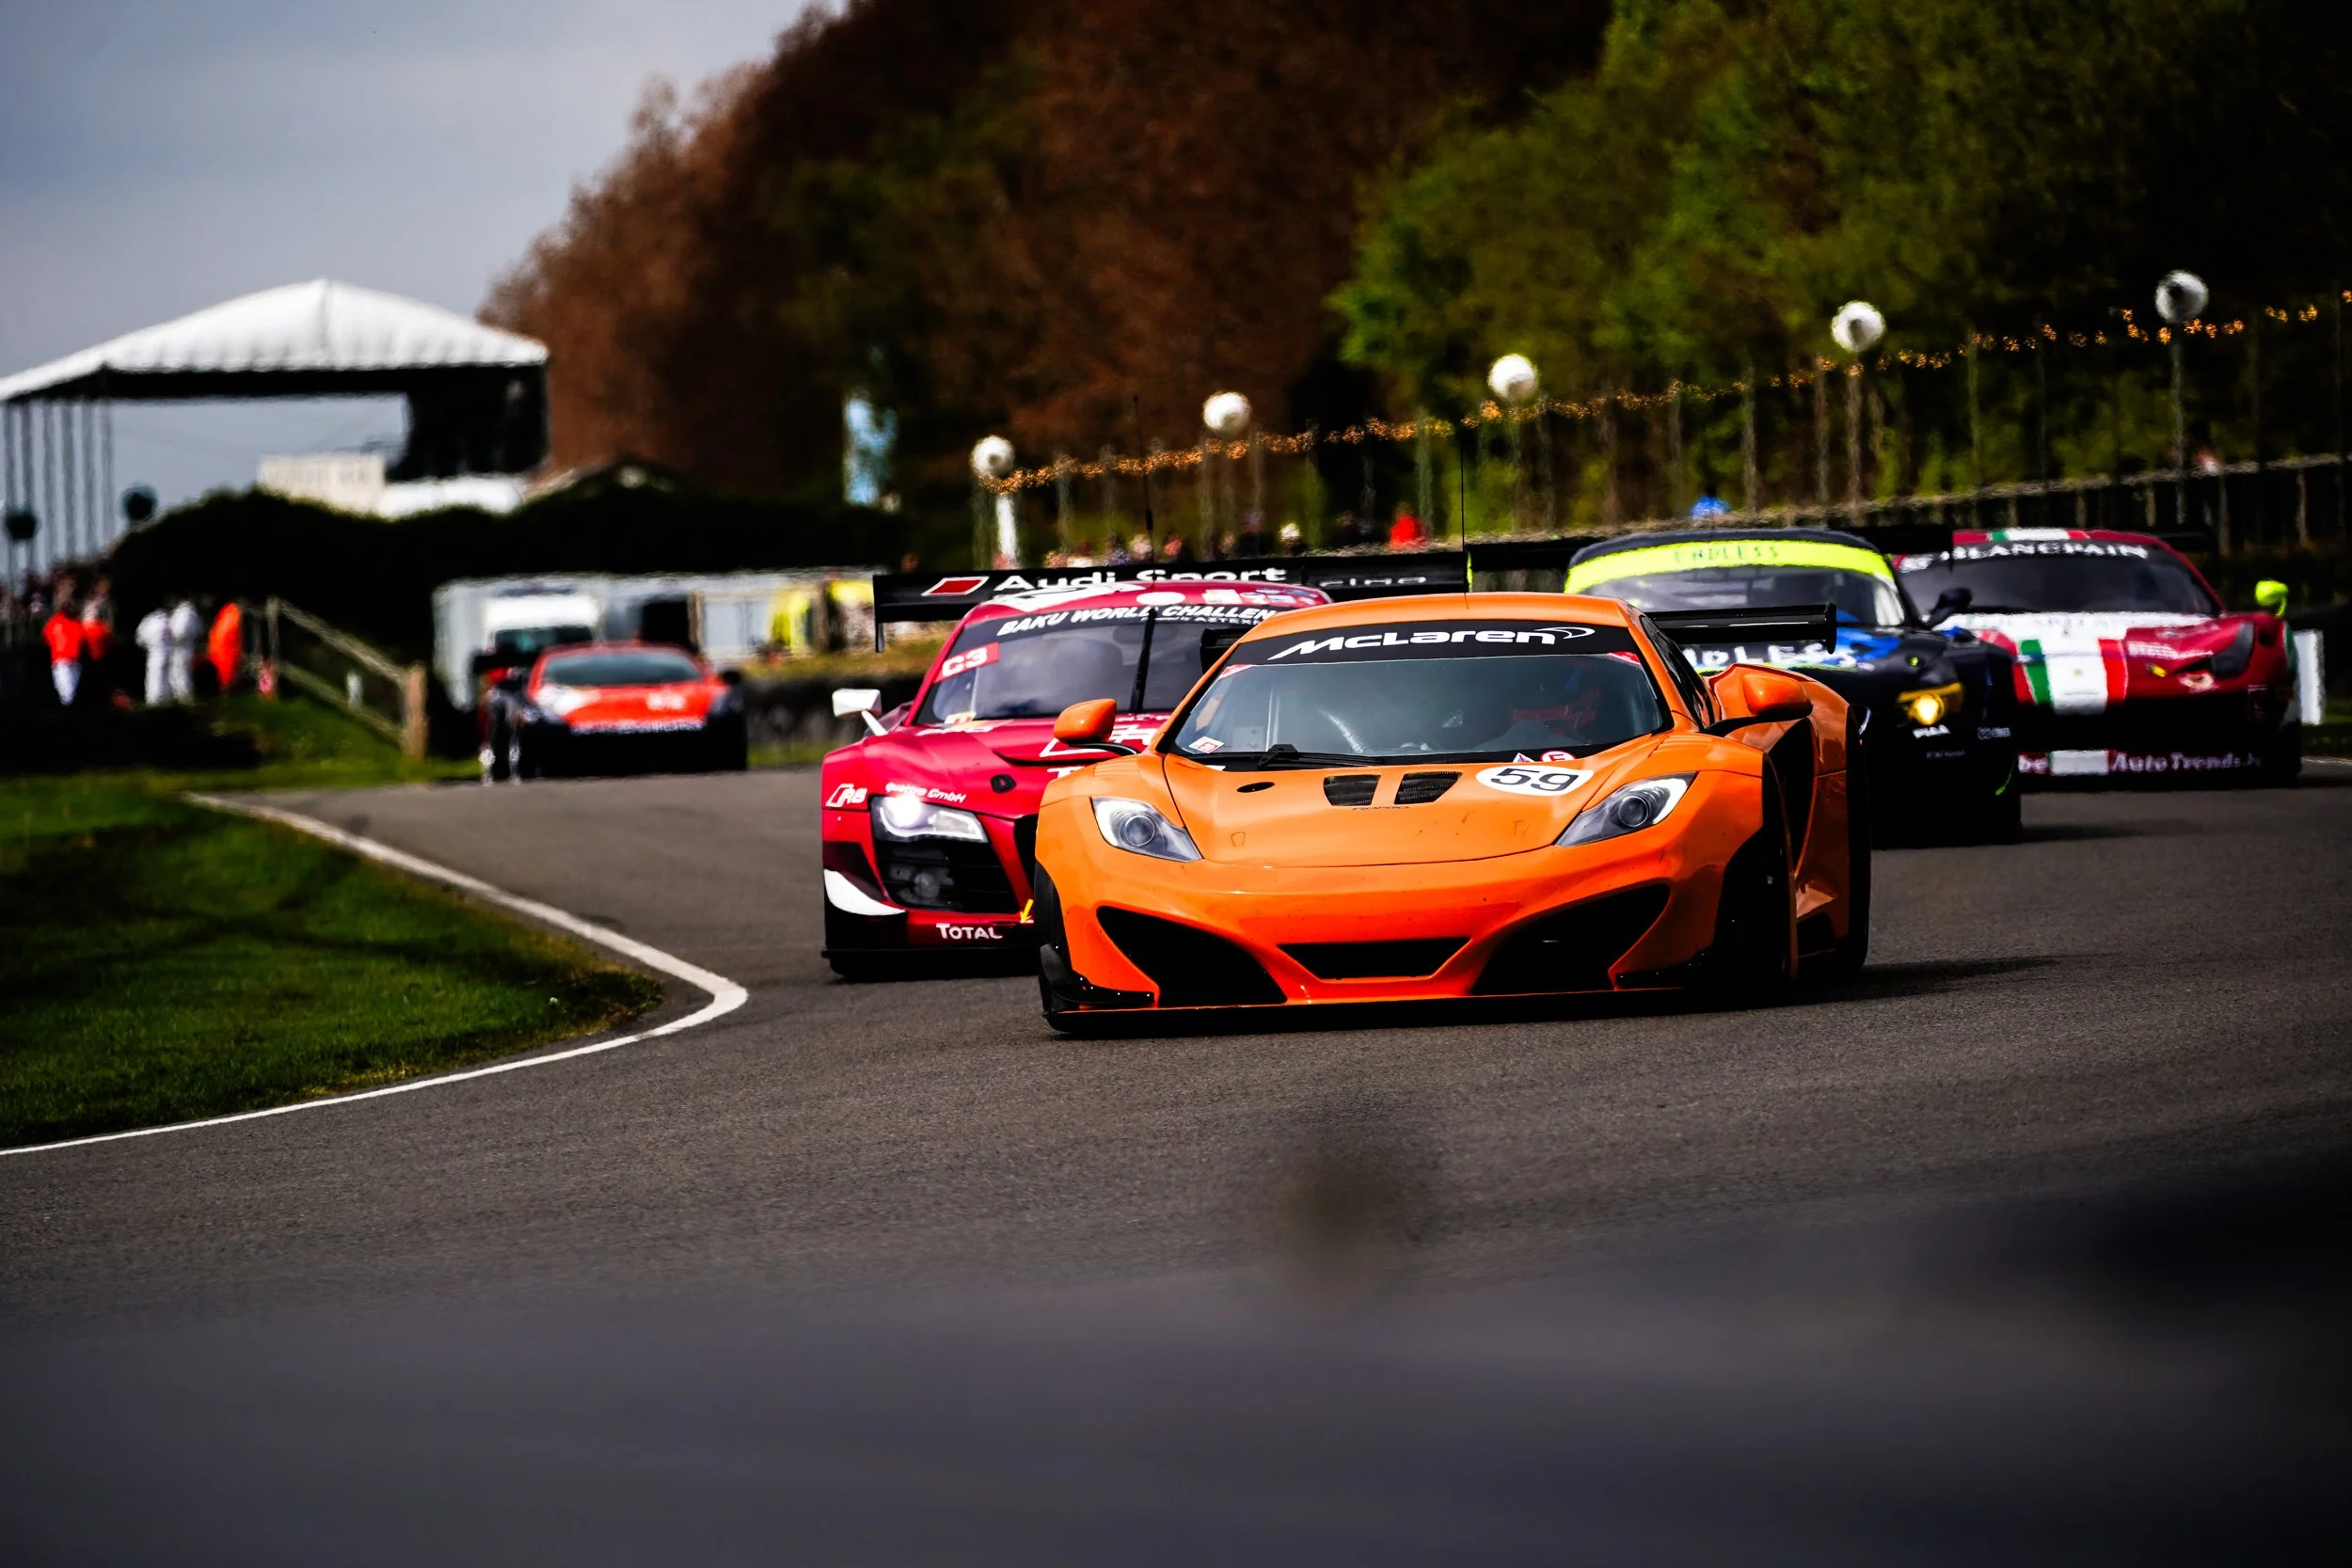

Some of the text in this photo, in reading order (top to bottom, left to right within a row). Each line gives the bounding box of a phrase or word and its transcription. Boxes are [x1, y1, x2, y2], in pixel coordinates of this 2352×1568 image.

[993, 570, 1117, 591] Audi
[996, 612, 1067, 637] BAKU
[1161, 605, 1277, 623] CHALLEN
[1267, 630, 1558, 660] McLaren
[942, 646, 989, 678] C3
[1490, 768, 1580, 792] 59
[928, 788, 966, 802] GmbH
[936, 923, 1003, 940] TOTAL
